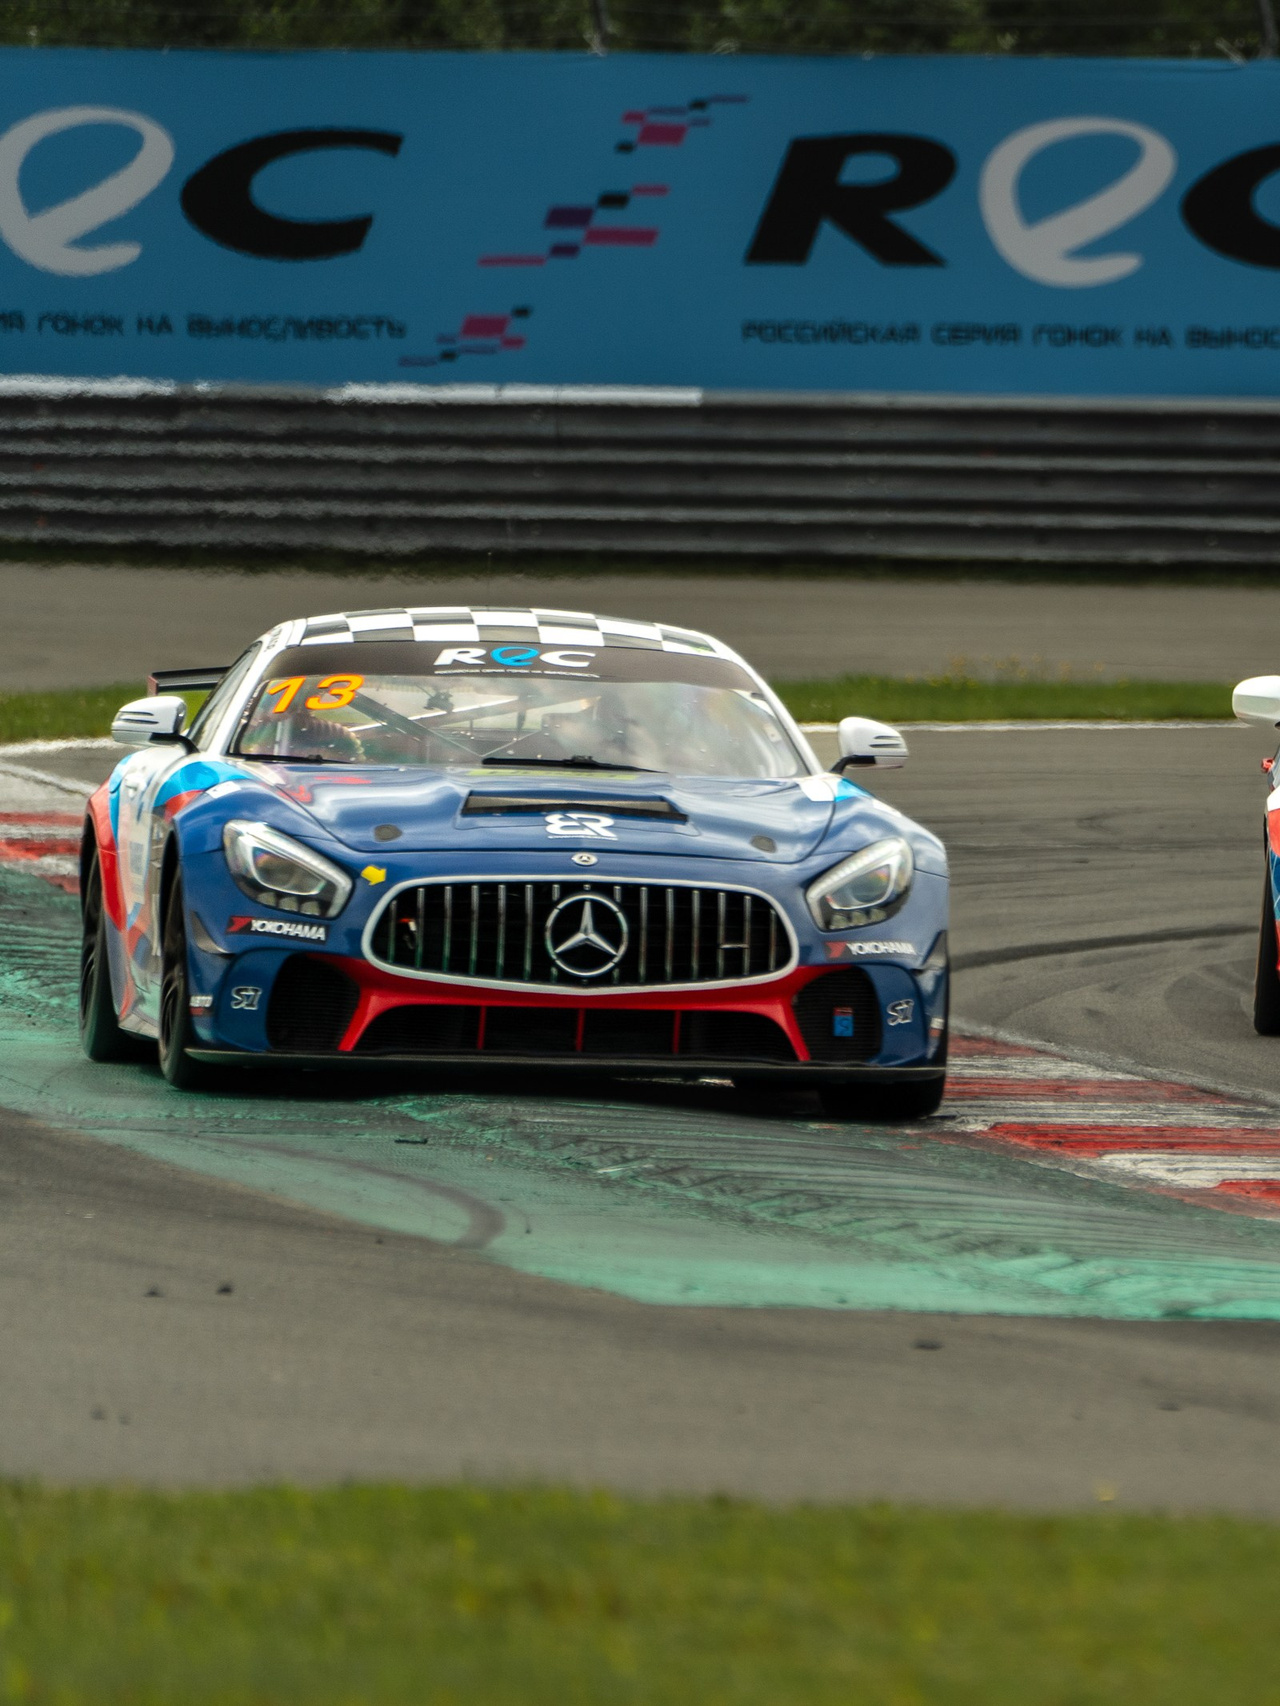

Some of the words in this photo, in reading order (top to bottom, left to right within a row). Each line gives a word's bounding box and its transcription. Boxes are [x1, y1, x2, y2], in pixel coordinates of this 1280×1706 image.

[0, 106, 404, 276] eC
[38, 312, 123, 336] ГОНОК
[137, 314, 173, 335] НА
[188, 314, 406, 341] ВЫНОСЛИВОСТЬ
[931, 322, 1021, 346] СЕРИЯ
[1033, 324, 1122, 347] ГОНОК
[1135, 326, 1171, 347] НА
[267, 673, 366, 714] 13
[250, 919, 326, 941] YOKOHAMA
[846, 941, 917, 956] YOKOHAMA
